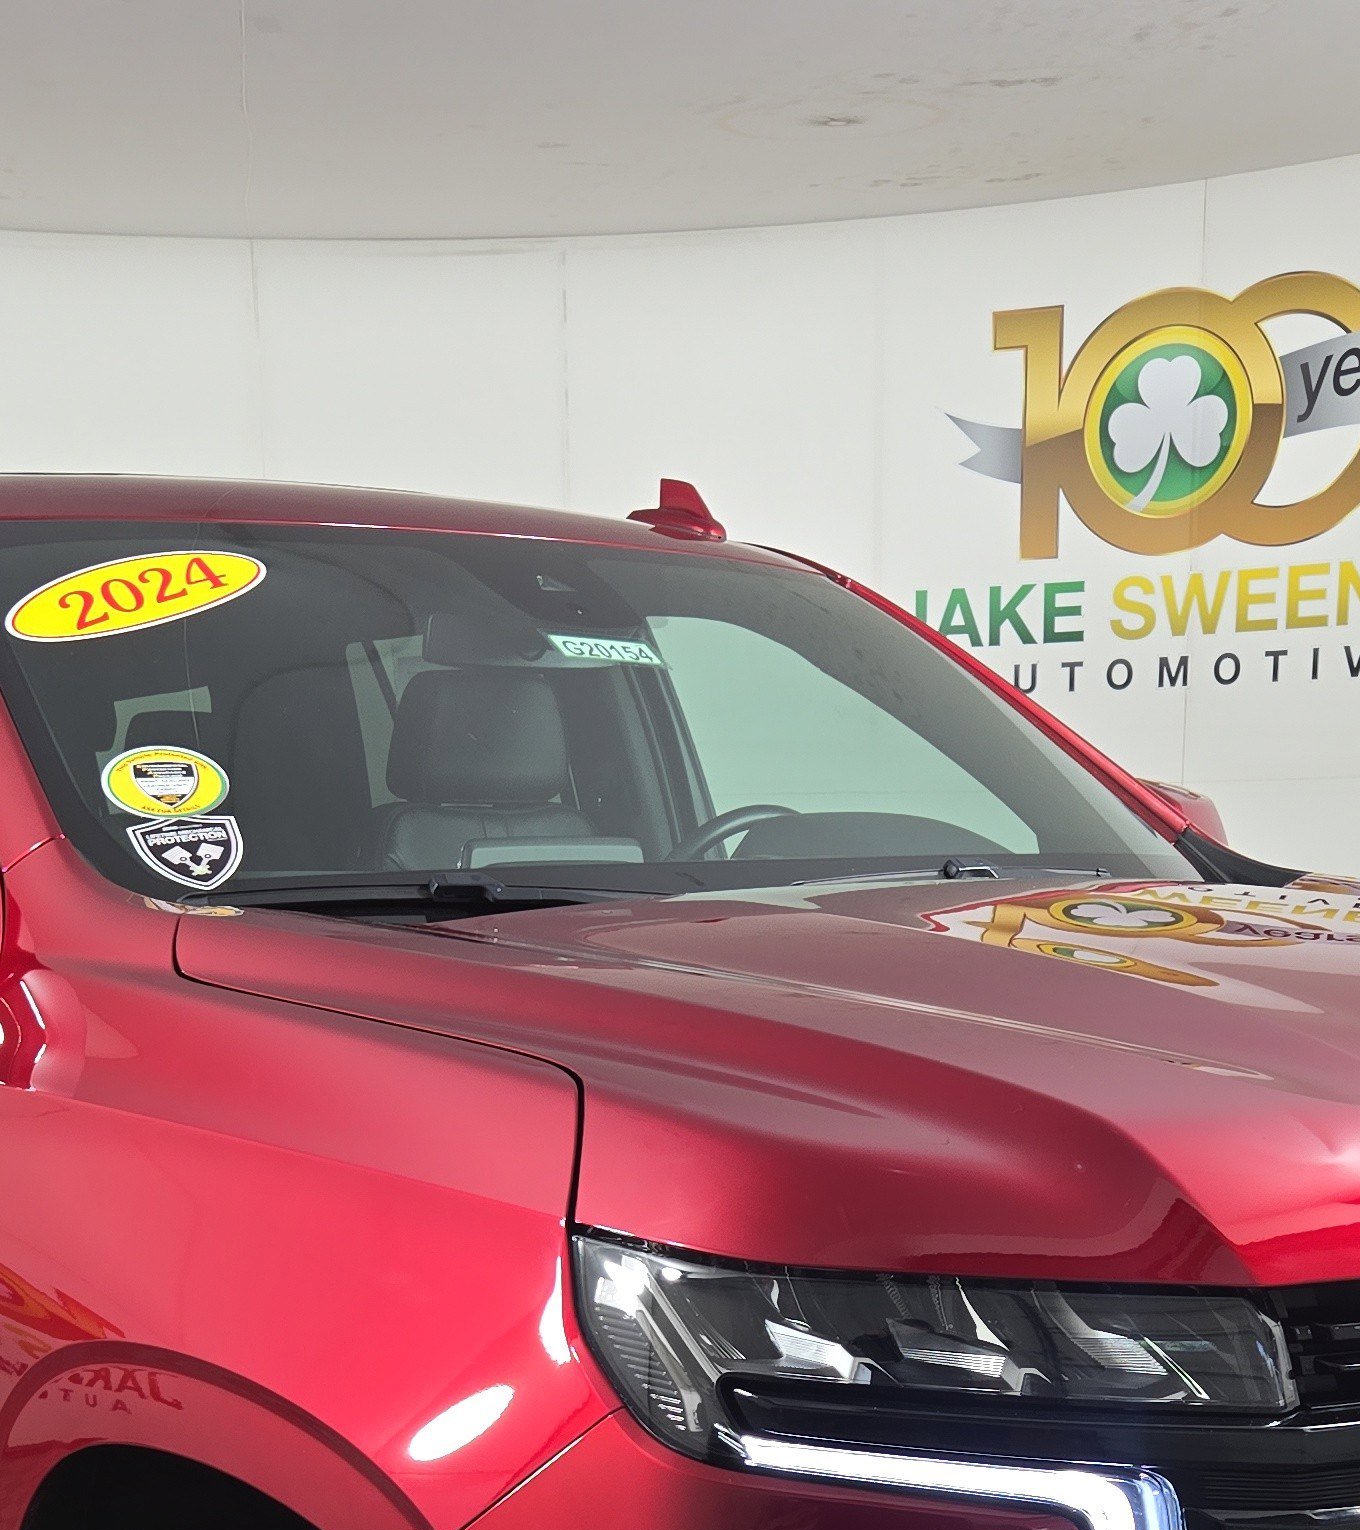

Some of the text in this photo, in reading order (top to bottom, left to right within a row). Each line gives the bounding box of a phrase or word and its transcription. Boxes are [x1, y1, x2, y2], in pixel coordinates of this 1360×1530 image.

[57, 556, 227, 631] 2024
[561, 640, 654, 663] G20154
[147, 830, 228, 847] PROTECTION
